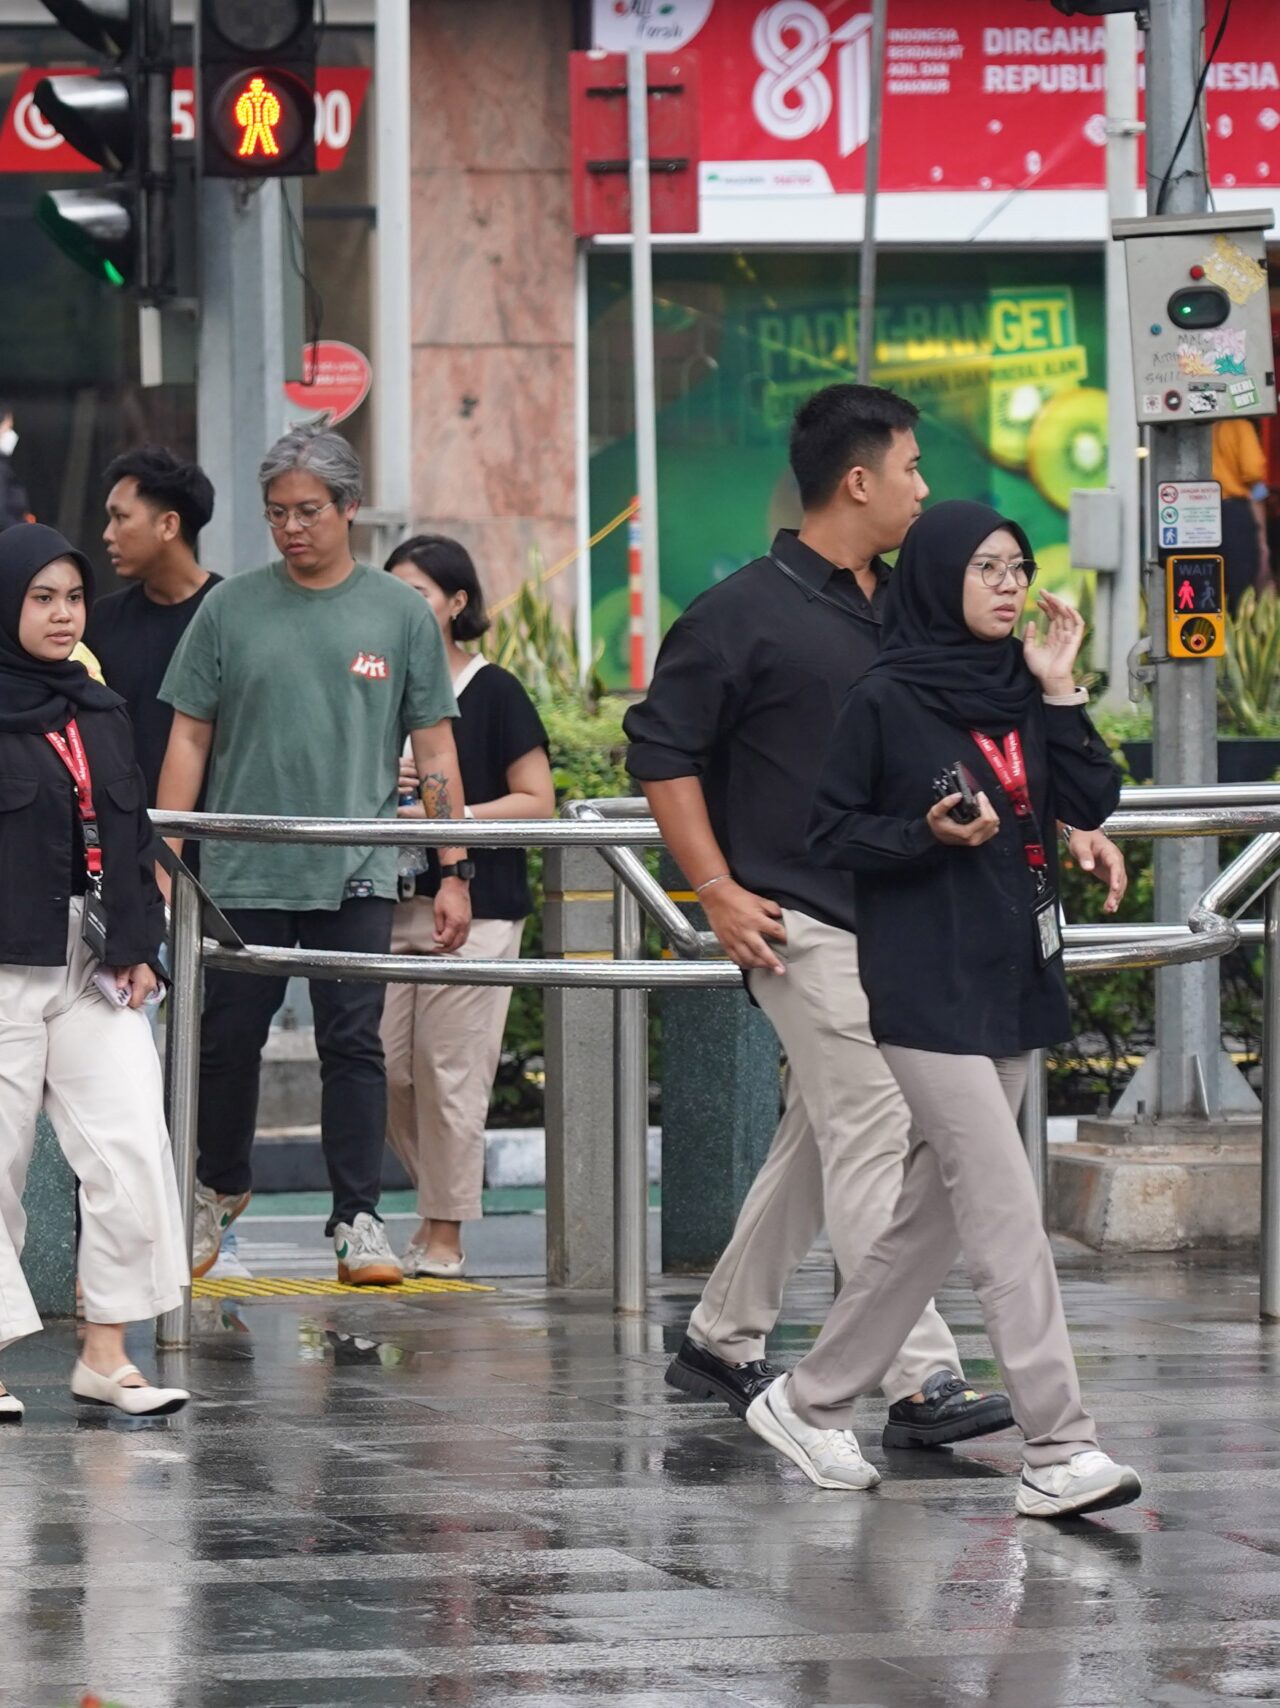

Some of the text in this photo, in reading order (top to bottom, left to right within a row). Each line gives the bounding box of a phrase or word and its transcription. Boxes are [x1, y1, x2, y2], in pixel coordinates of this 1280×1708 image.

[983, 27, 1145, 55] DIRGAHA
[752, 0, 873, 158] 81
[984, 64, 1105, 92] REPUBLI
[1178, 564, 1214, 576] WAIT
